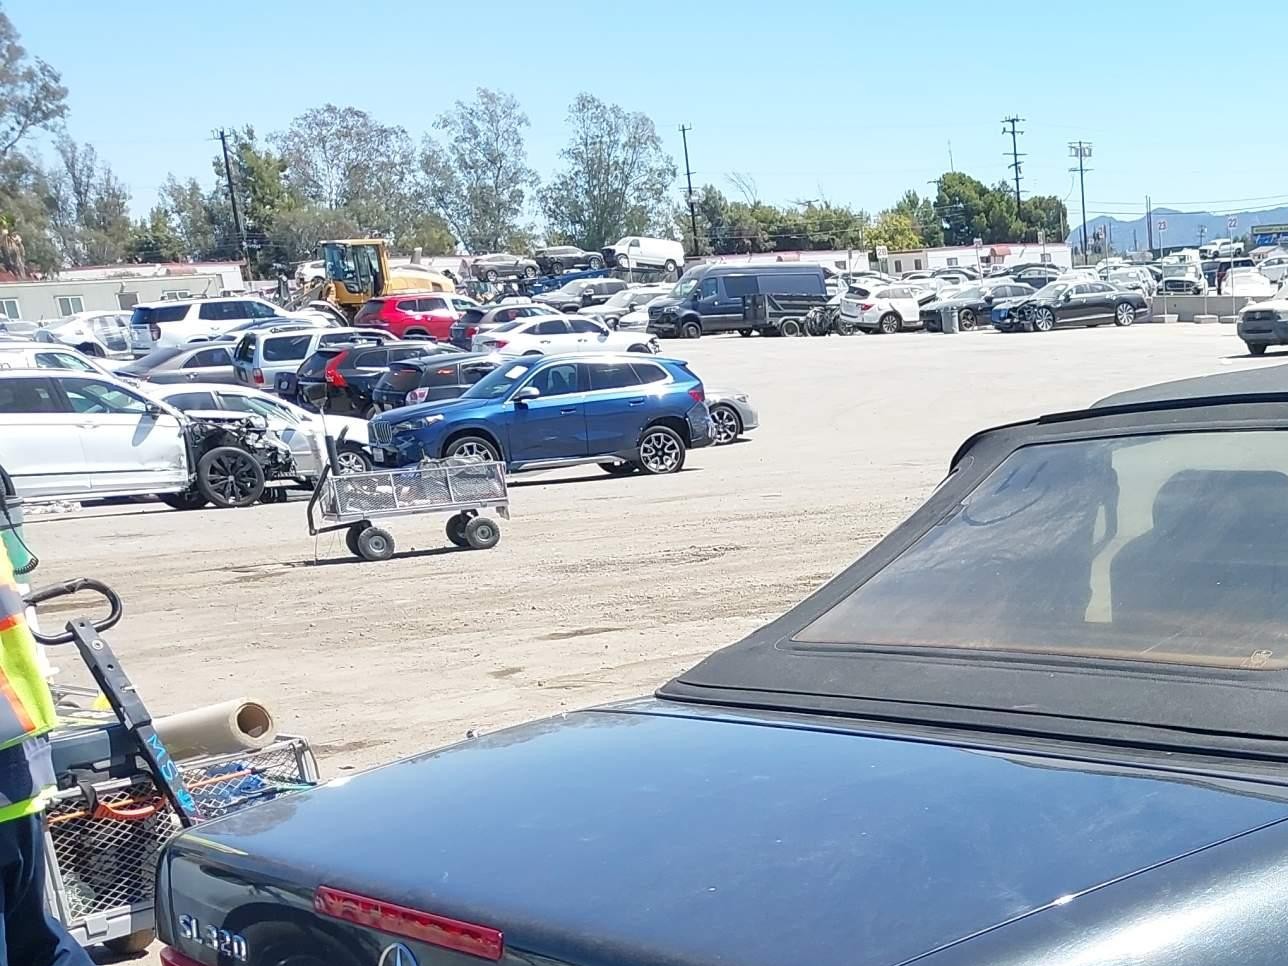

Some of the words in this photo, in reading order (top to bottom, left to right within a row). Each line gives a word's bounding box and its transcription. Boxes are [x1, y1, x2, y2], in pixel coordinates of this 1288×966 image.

[1228, 218, 1237, 228] 22
[179, 914, 203, 945] SL
[206, 924, 248, 962] 320
